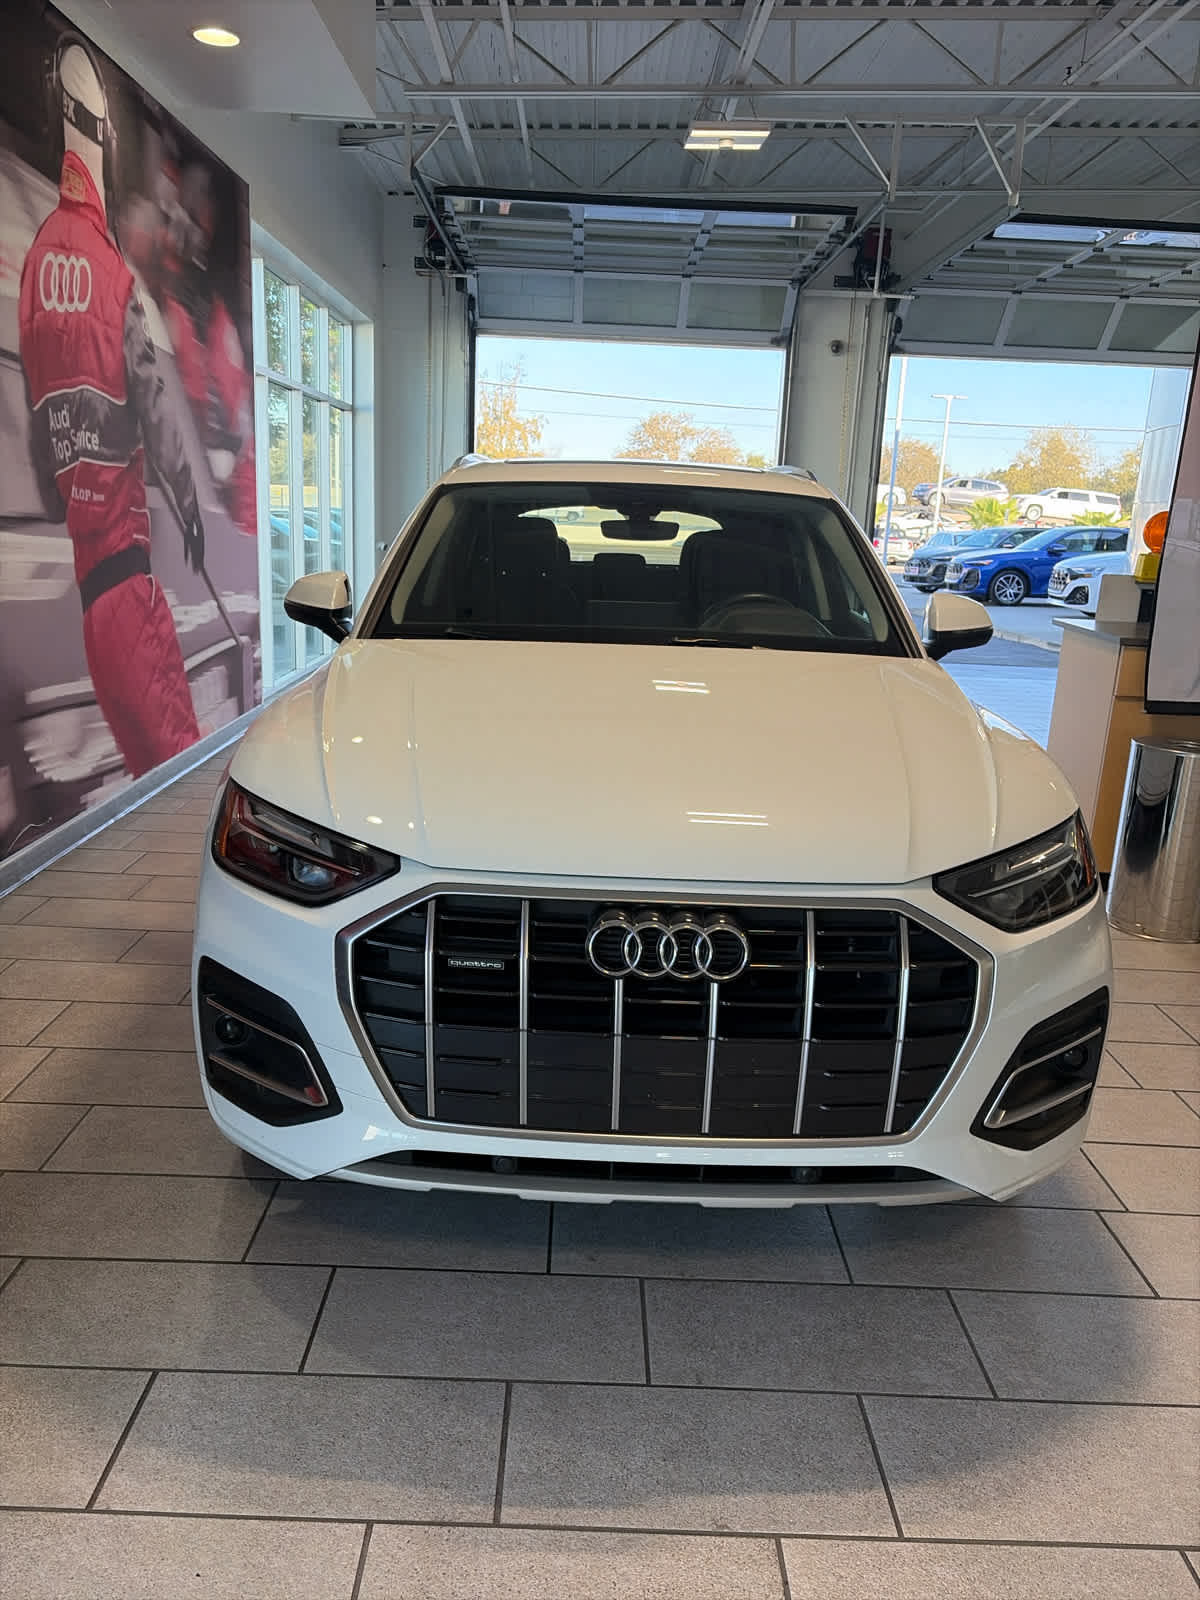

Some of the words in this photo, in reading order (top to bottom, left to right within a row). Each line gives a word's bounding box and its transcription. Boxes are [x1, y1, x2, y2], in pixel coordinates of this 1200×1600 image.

[48, 403, 70, 432] Audi
[51, 437, 71, 463] Top
[449, 959, 503, 969] quattro
